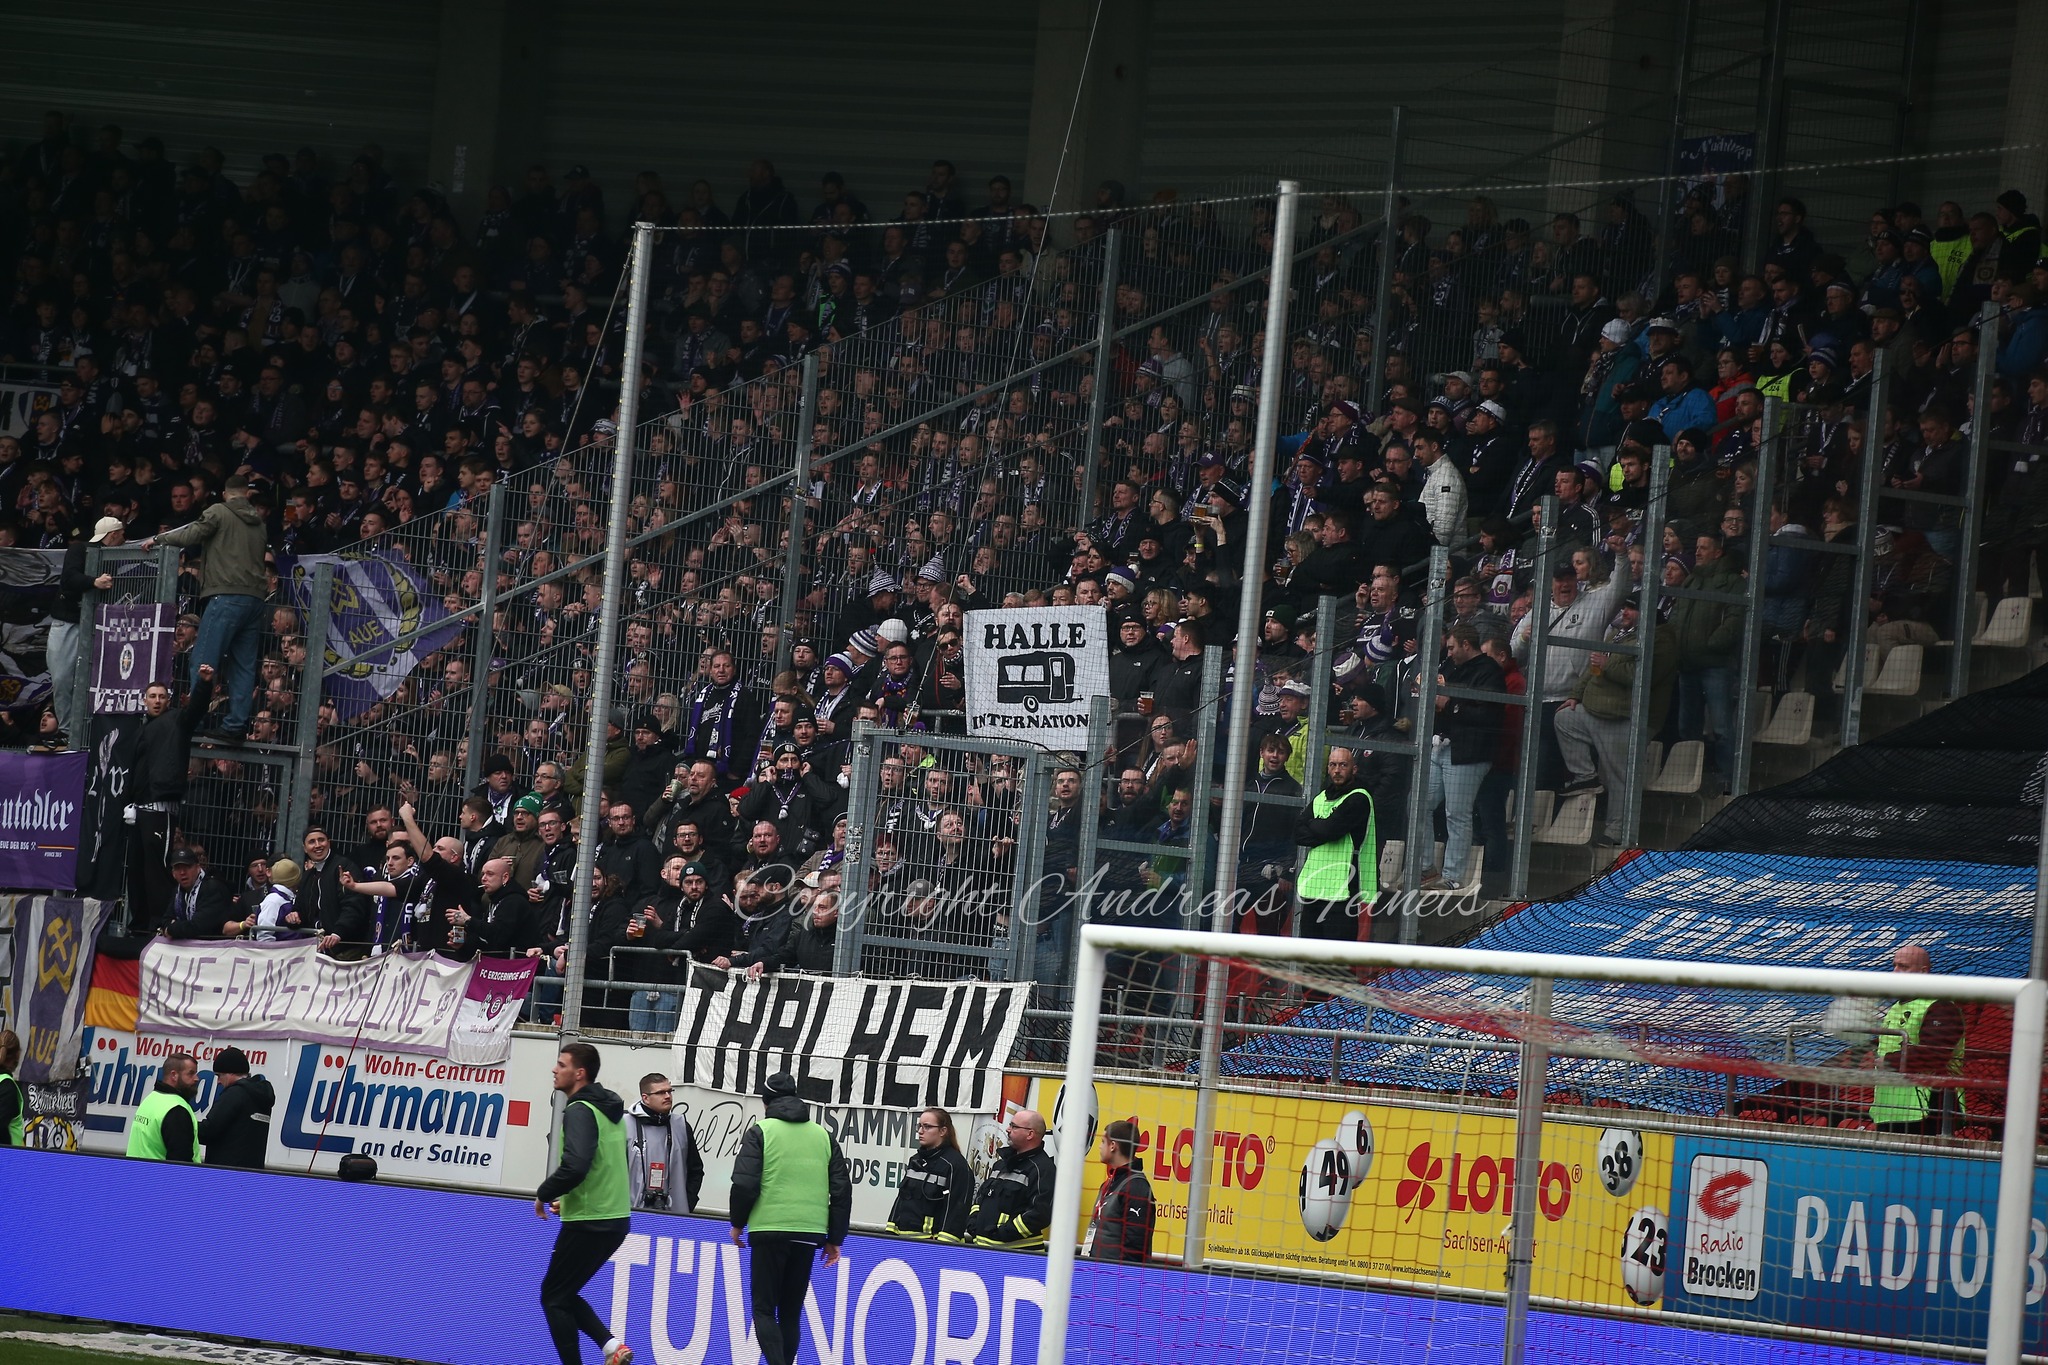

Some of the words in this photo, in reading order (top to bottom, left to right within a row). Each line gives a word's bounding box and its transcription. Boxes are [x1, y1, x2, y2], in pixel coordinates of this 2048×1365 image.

[348, 620, 384, 648] AUE
[984, 623, 1086, 649] HALLE
[973, 713, 1090, 729] INTERNATION
[0, 788, 74, 832] utadler
[480, 968, 487, 978] FC
[488, 970, 519, 981] ERZGEBIRGE
[684, 965, 1013, 1109] THALHEIM
[365, 1054, 505, 1085] Wohn-Centrum
[280, 1043, 505, 1154] Lührmann
[361, 1141, 385, 1158] an
[391, 1139, 423, 1160] der
[427, 1143, 492, 1167] Saline
[1153, 1126, 1264, 1191] LOTO
[1319, 1150, 1349, 1196] 49
[1602, 1140, 1633, 1190] 38
[1448, 1152, 1571, 1221] LOTO
[1318, 1256, 1338, 1266] Beratung
[1631, 1217, 1667, 1276] 23
[1700, 1230, 1744, 1255] Radio
[1792, 1195, 1989, 1299] RADIO
[1687, 1256, 1756, 1292] Brocken
